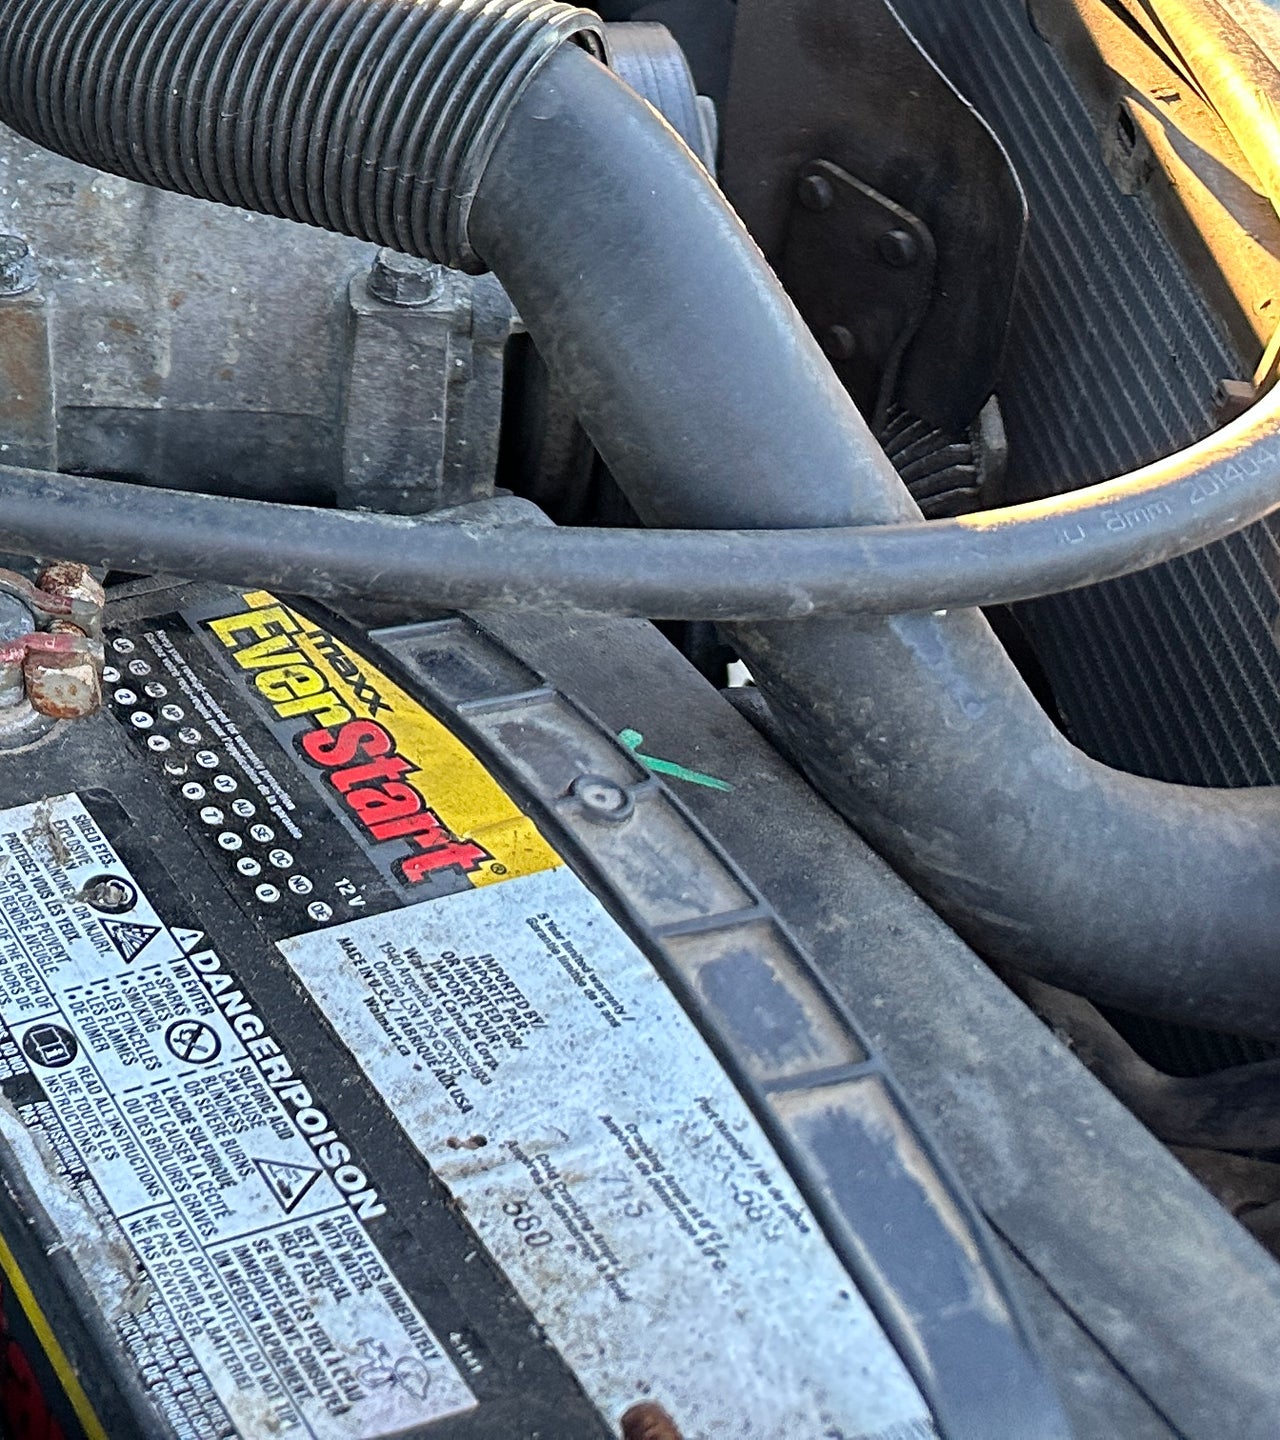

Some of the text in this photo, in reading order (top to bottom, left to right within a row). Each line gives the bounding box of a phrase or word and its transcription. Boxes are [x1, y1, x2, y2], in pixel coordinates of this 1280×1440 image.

[304, 627, 394, 718] maxx
[205, 602, 496, 885] EverStart
[51, 818, 95, 867] EXPLOSIVE
[70, 813, 119, 868] SHIELD EYES.
[3, 872, 46, 922] EXPLOSIFS
[33, 921, 73, 965] PEUVENT
[43, 899, 84, 944] LES YEUX.
[331, 877, 367, 908] 12 V
[1, 941, 26, 963] THE
[21, 931, 61, 977] AVEUGLE.
[70, 905, 116, 958] OR INJURY.
[335, 936, 377, 979] MADE IN
[13, 961, 46, 997] REACH
[153, 976, 192, 1016] SPARKS
[168, 963, 194, 983] NO
[370, 959, 440, 1040] Ontario L5N 1P9
[438, 949, 506, 1023] OR IMPORTED
[476, 952, 533, 1011] IMPORTED
[523, 916, 623, 1028] Garantie de ans
[542, 920, 627, 1016] Year limited warranty
[13, 995, 35, 1011] DE
[32, 994, 54, 1010] OF
[66, 1000, 112, 1053] DE FUMER
[84, 996, 141, 1066] LES FLAMMES
[101, 990, 127, 1012] LES
[119, 985, 163, 1034] SMOKING
[137, 980, 175, 1021] FLAMES
[361, 996, 416, 1057] Walmart.ca
[376, 940, 495, 1087] 1940 Argentia Mississauga
[400, 946, 504, 1072] Wal-Mart Canada Corp.
[467, 1010, 503, 1043] POUR
[6, 1054, 30, 1076] NOT
[56, 1070, 85, 1097] LIRE
[74, 1065, 104, 1095] READ
[184, 948, 390, 1222] DANGER/POISON
[40, 1074, 101, 1158] INSTRUCTIONS.
[70, 1095, 109, 1140] TOUTES
[91, 1094, 117, 1117] ALL
[180, 1080, 259, 1181] OR SEVERE BURNS.
[199, 1074, 251, 1135] BLINDNESS
[213, 1070, 266, 1130] CAN CAUSE
[233, 1065, 297, 1141] SULFURIC ACID
[95, 1138, 122, 1162] LES
[103, 1115, 167, 1201] INSTRUCTIONS.
[140, 1091, 209, 1180] PEUT CAUSER LA
[159, 1085, 238, 1190] L'ACIDE SULFURIQUE
[619, 1122, 695, 1206] Cranking Amps
[711, 1119, 755, 1162] Number
[121, 1097, 221, 1241] OU DES GRAVES.
[499, 1198, 557, 1249] 580
[531, 1152, 622, 1266] Cold Cranking Amps
[125, 1219, 209, 1343] NE PAS RENVERSER.
[139, 1213, 208, 1308] NE PAS OUVRIR
[272, 1229, 328, 1294] HELP FAST.
[290, 1224, 355, 1304] GET MEDICAL
[313, 1218, 377, 1296] WITH WATER.
[330, 1212, 443, 1362] FLUSH EYES IMMEDIATELY
[158, 1208, 285, 1401] DO NOT OPEN DO NOT
[209, 1248, 317, 1405] UN RAPIDEMENT.
[249, 1236, 338, 1356] SE RINCER LES YEUX
[291, 1344, 352, 1417] CONSULTER
